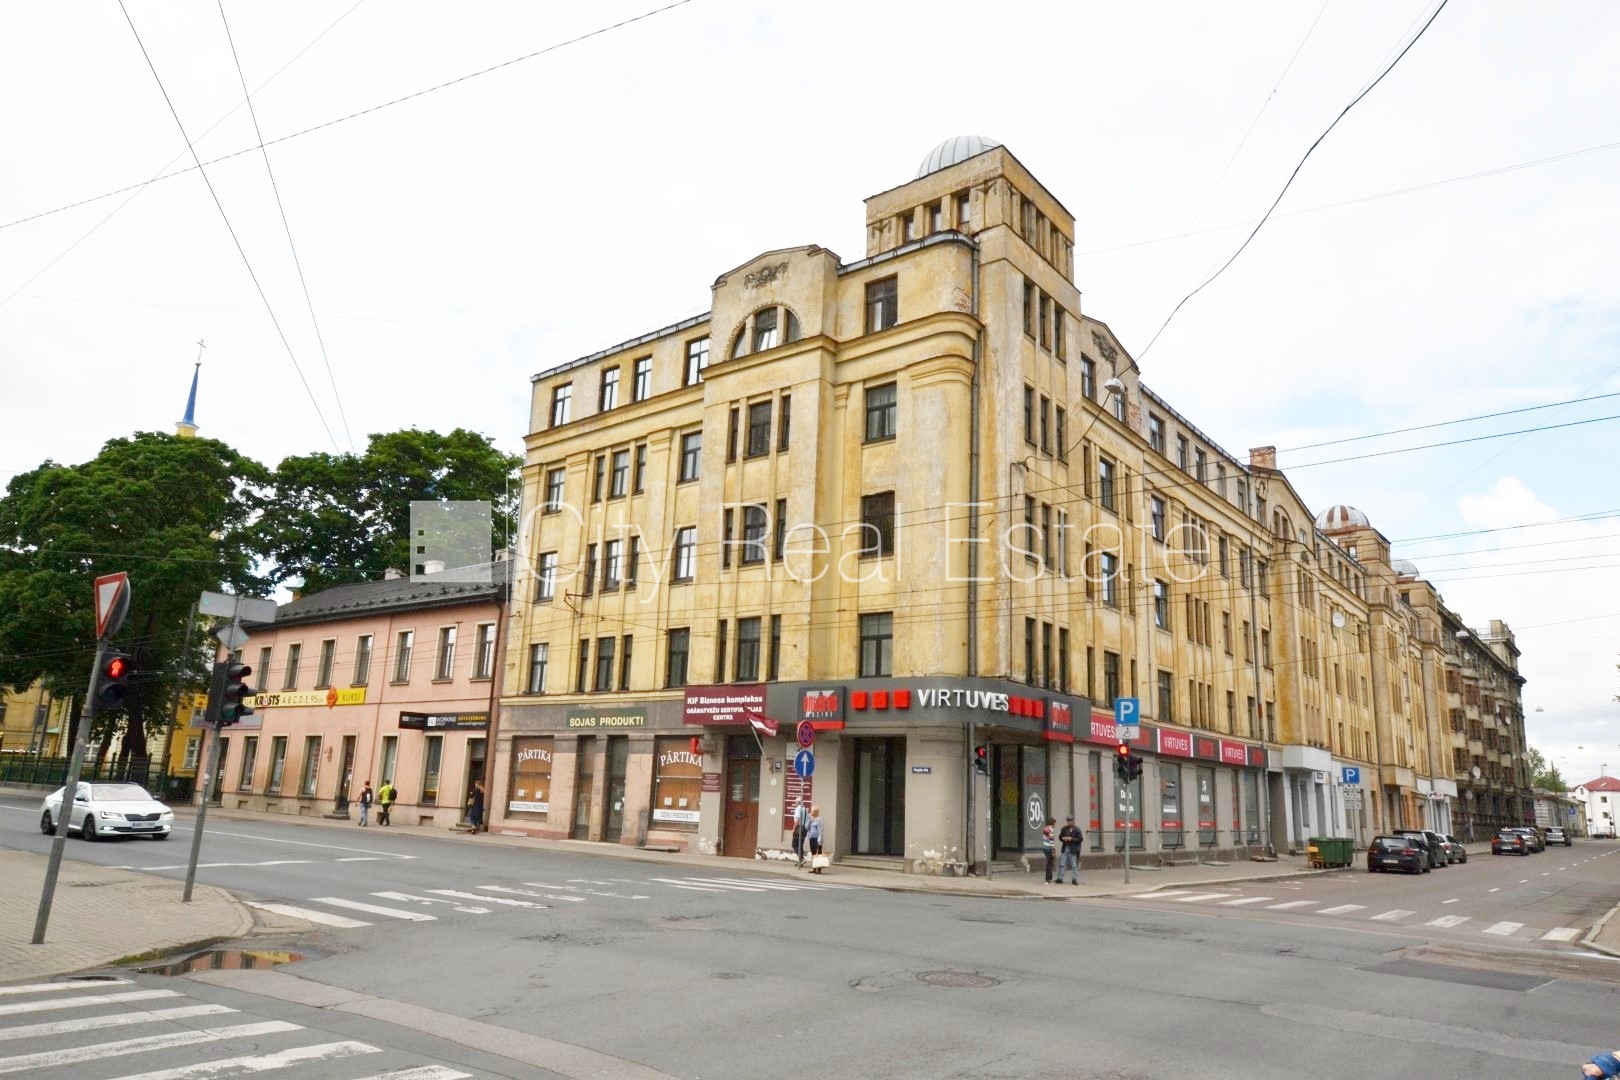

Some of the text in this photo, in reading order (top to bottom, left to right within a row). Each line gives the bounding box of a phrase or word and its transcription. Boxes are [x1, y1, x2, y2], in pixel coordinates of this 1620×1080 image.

[342, 694, 360, 702] KURSI
[687, 696, 763, 705] KIF Biznesa komplekss
[917, 689, 1009, 712] VIRTUVES
[1120, 701, 1134, 722] P
[569, 716, 644, 727] SOJAS PRODUKTI
[1164, 735, 1188, 751] VIRTUVES
[518, 748, 551, 763] PĀRTIKA
[660, 750, 703, 767] PĀRTIKA
[1224, 746, 1244, 760] VIRTUVES
[1345, 768, 1356, 781] P
